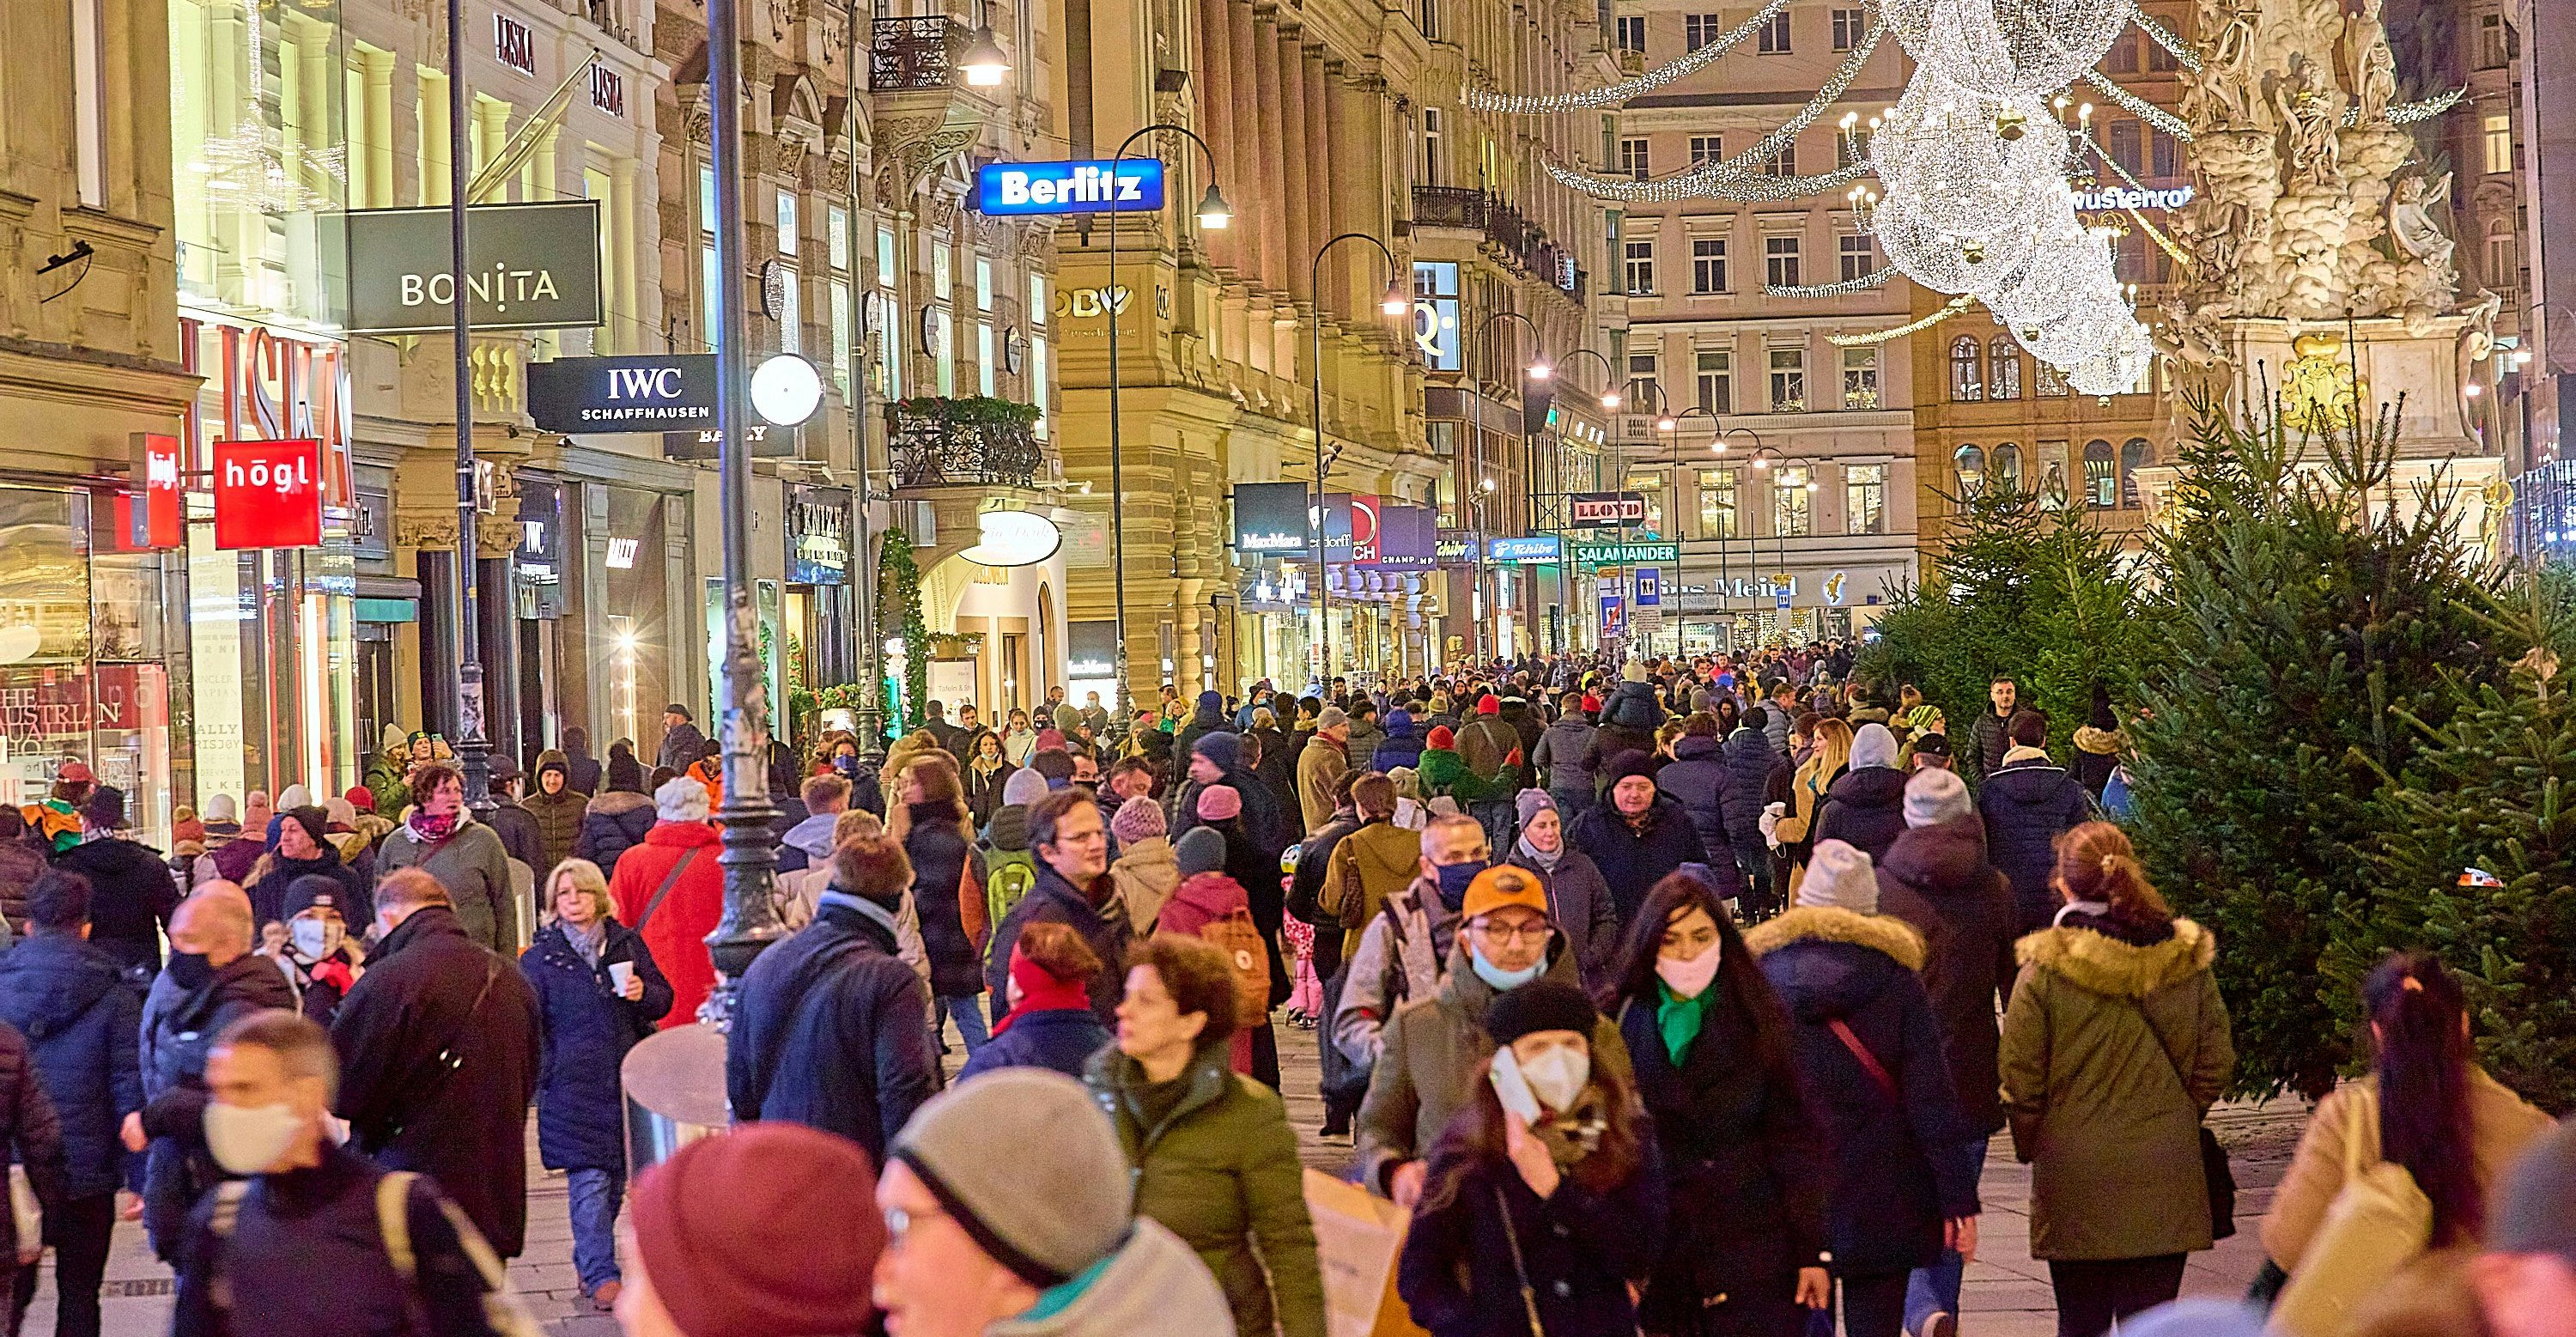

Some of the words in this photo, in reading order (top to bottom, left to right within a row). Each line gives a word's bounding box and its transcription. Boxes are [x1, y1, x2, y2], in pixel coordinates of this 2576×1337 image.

[1001, 167, 1142, 205] Berlitz
[1557, 249, 1566, 286] PENSION
[607, 368, 683, 399] IWC
[581, 406, 709, 421] SCHAFFHAUSEN
[698, 425, 767, 443] BAY
[1578, 504, 1639, 517] LLOYD
[802, 502, 842, 539] KNIZE
[526, 521, 544, 555] IWC
[1242, 532, 1303, 549] MaxMara
[1511, 543, 1556, 556] Tchibo
[1577, 546, 1675, 562] SALAMANDER
[1382, 556, 1415, 564] CHAMP
[1417, 556, 1434, 565] MP
